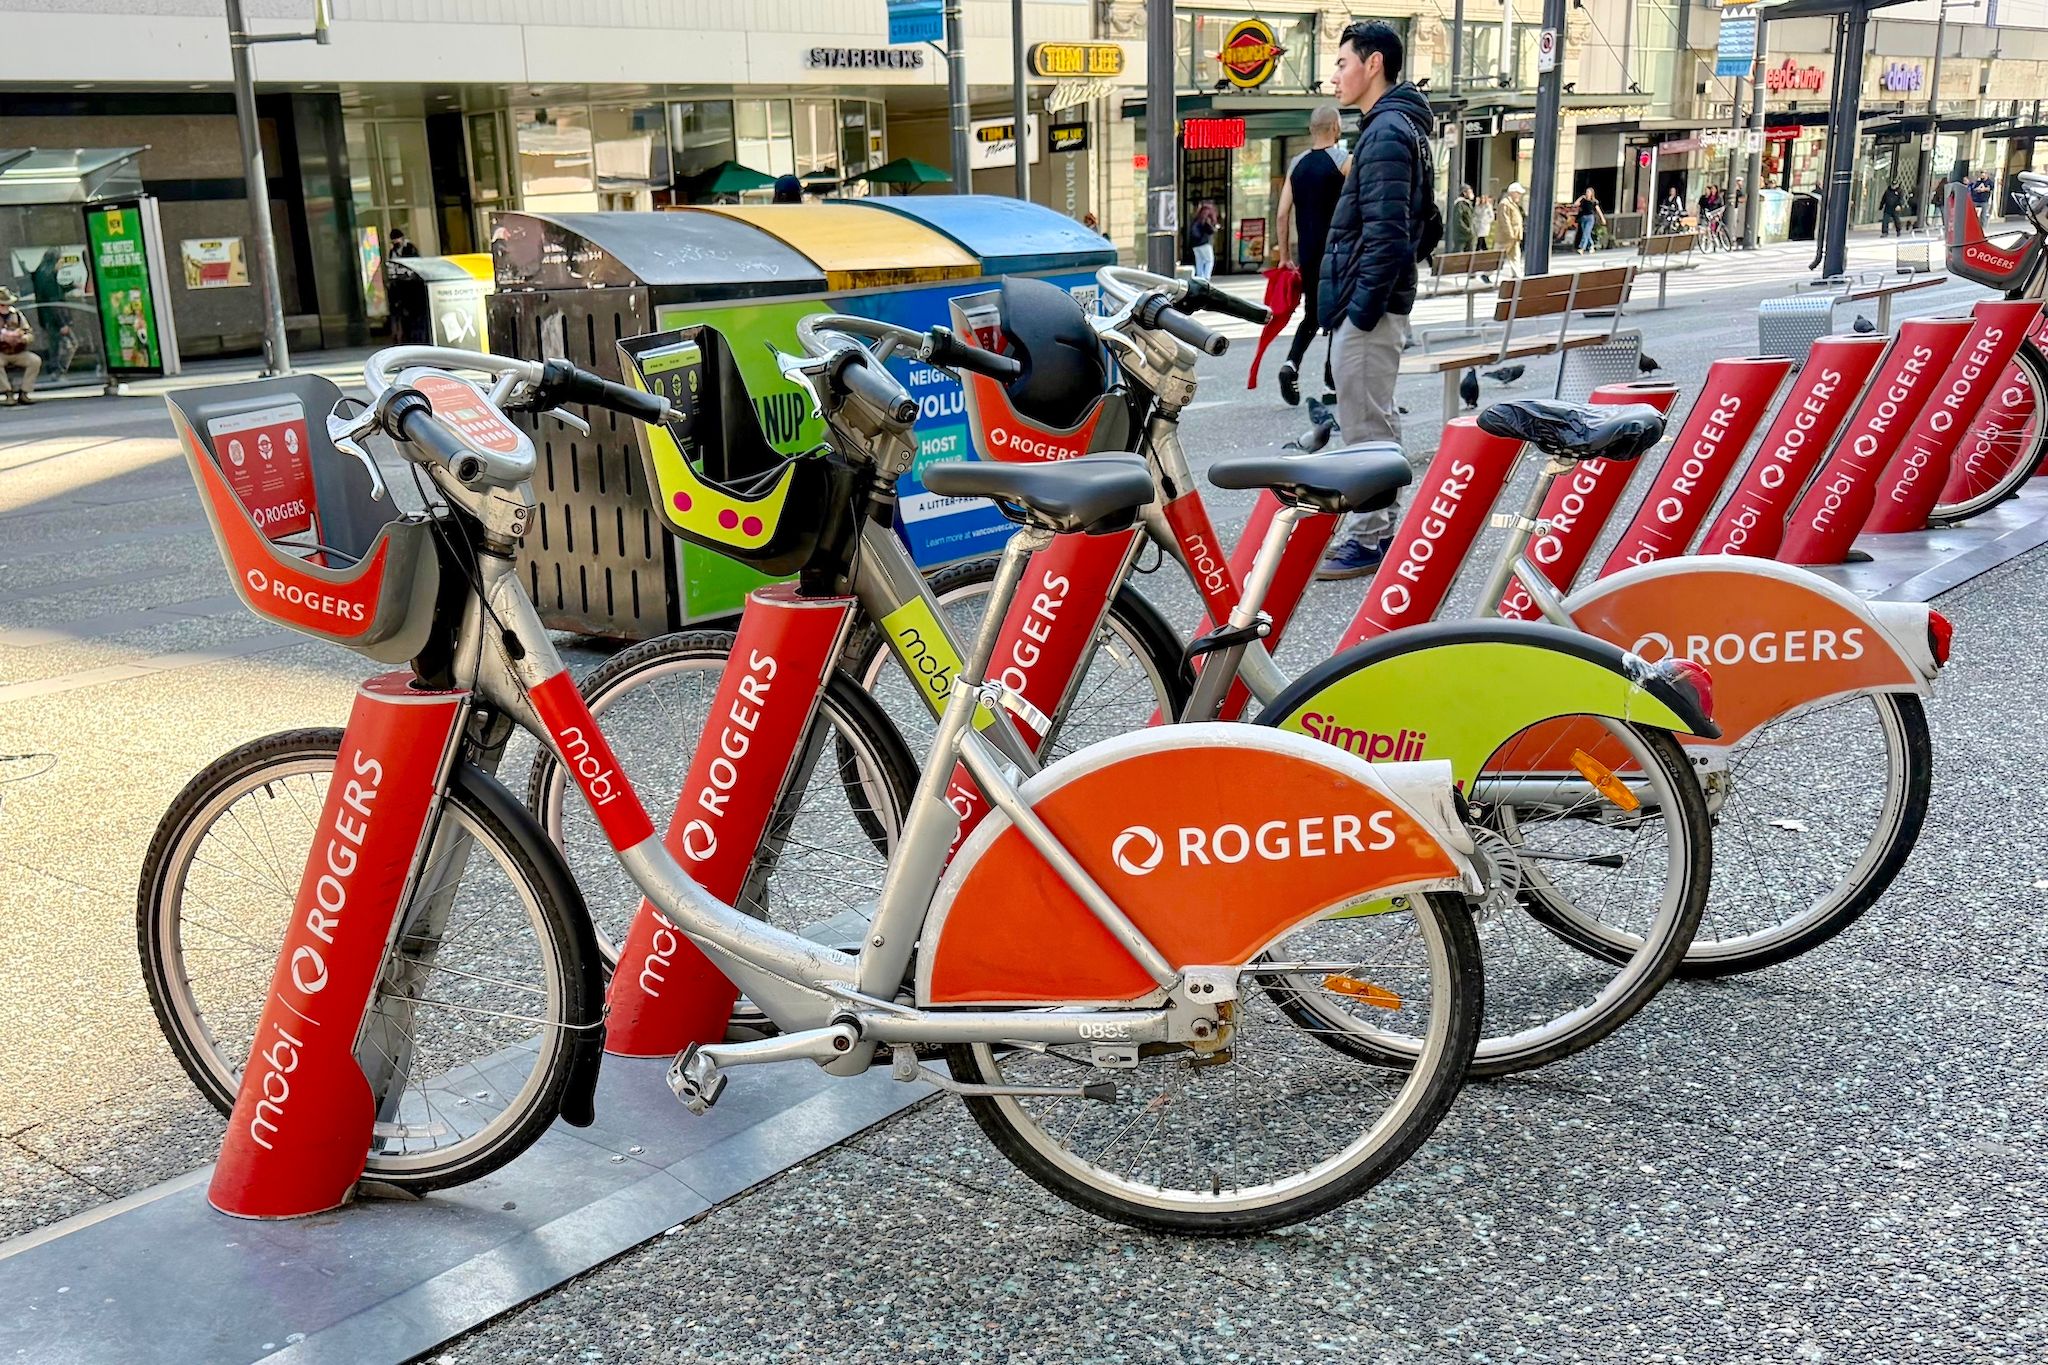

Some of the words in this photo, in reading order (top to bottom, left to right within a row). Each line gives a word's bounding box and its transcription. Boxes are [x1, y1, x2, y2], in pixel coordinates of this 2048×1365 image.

[808, 47, 924, 69] STARBUCKS
[1046, 47, 1084, 72] TOM
[1089, 47, 1120, 72] LEE
[1065, 160, 1075, 218] COUVER
[1977, 252, 2015, 270] ROGERS
[1868, 345, 1933, 433] ROGERS
[1944, 326, 2003, 410] ROGERS
[752, 392, 804, 445] NUP
[916, 390, 968, 420] VOLU
[1775, 368, 1842, 463] ROGERS
[921, 435, 957, 456] HOST
[1671, 393, 1741, 495] ROGERS
[1965, 420, 2003, 474] mobi
[1551, 458, 1607, 534] ROGE
[1812, 472, 1855, 532] mobi
[1891, 446, 1931, 503] mobi
[265, 499, 307, 524] ROGERS
[926, 536, 945, 548] Learn
[946, 534, 964, 543] more
[964, 532, 972, 540] at
[1397, 459, 1475, 583] ROGERS
[1185, 533, 1229, 596] mobi
[272, 580, 365, 622] ROGERS
[1001, 569, 1071, 719] OGERS
[1686, 628, 1865, 667] ROGERS
[698, 649, 778, 818] ROGERS
[1301, 712, 1427, 763] Simplii
[559, 726, 622, 807] mobi
[305, 748, 384, 945] ROGERS
[1178, 810, 1396, 867] ROGERS
[250, 1023, 304, 1151] mobi
